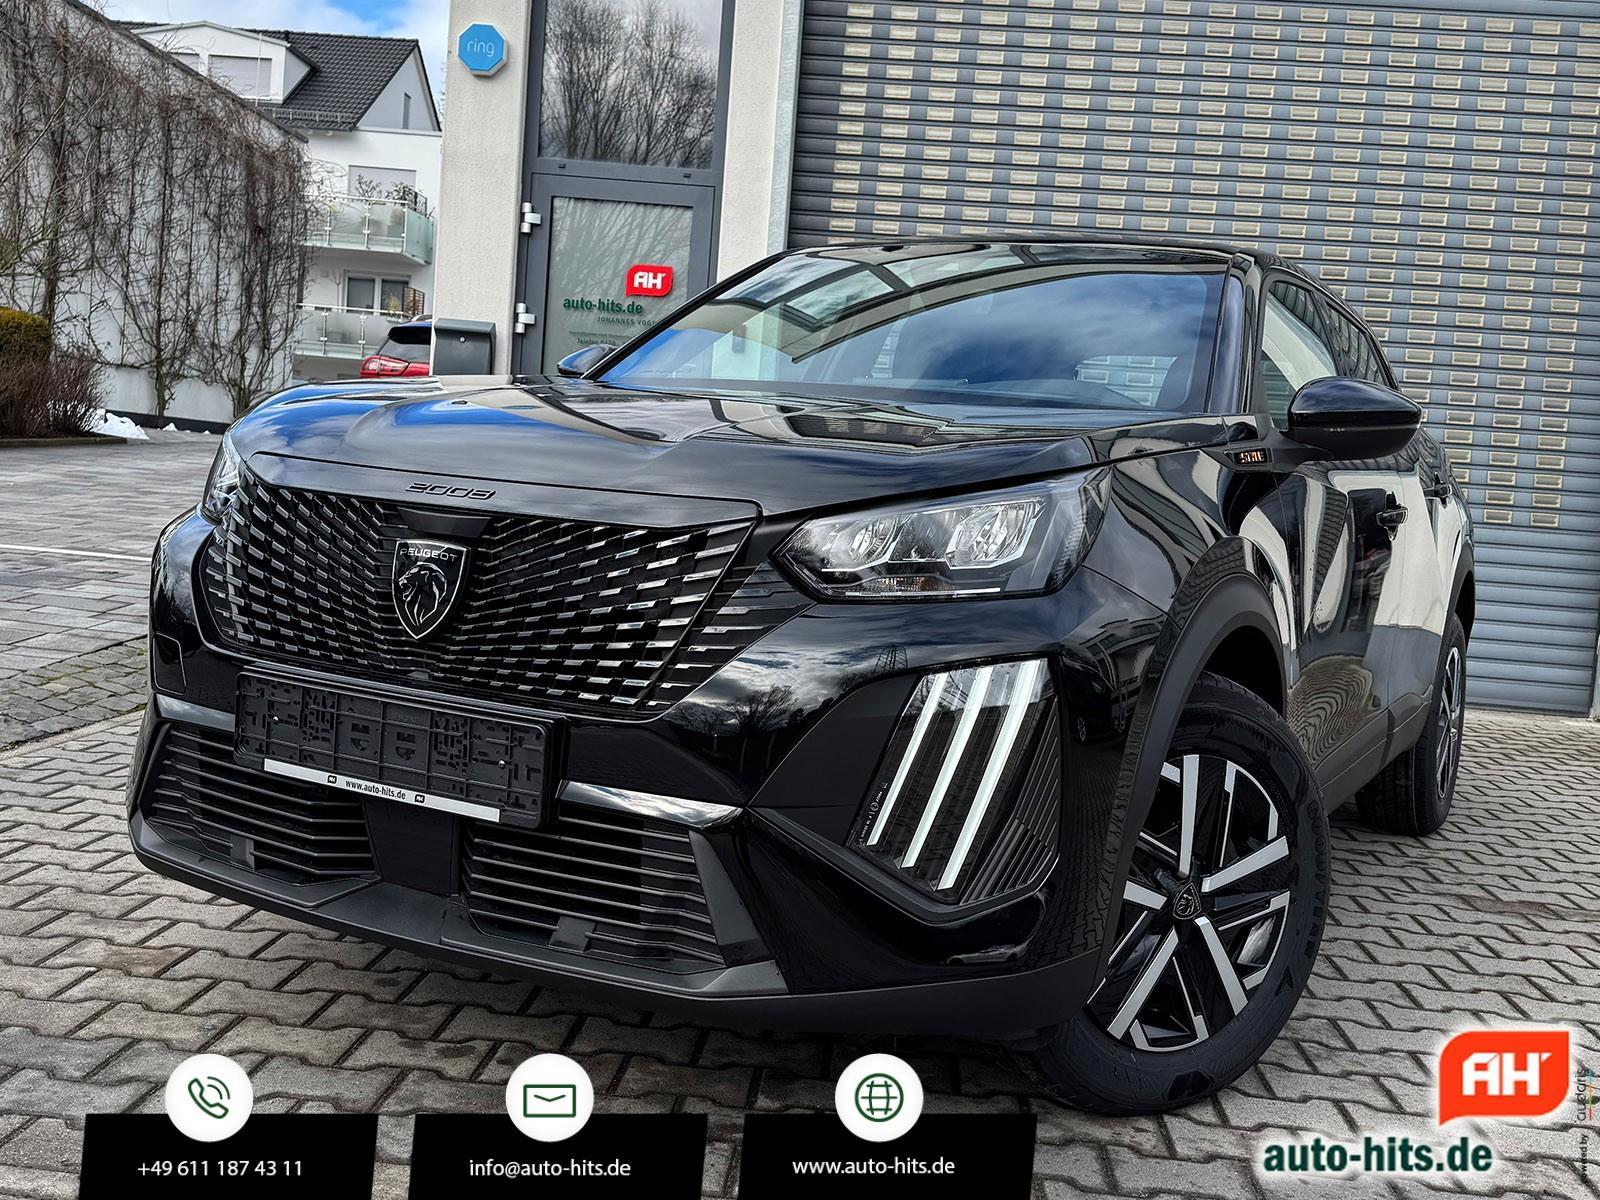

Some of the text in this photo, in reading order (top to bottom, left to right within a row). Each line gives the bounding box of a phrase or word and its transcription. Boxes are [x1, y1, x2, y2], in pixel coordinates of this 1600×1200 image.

[466, 37, 495, 58] ring
[562, 298, 644, 315] auto-hits.de
[597, 316, 634, 325] JOHANNES
[405, 483, 496, 500] 2008
[400, 548, 458, 562] PEUGEOT
[345, 780, 406, 800] www.auto-hits.de
